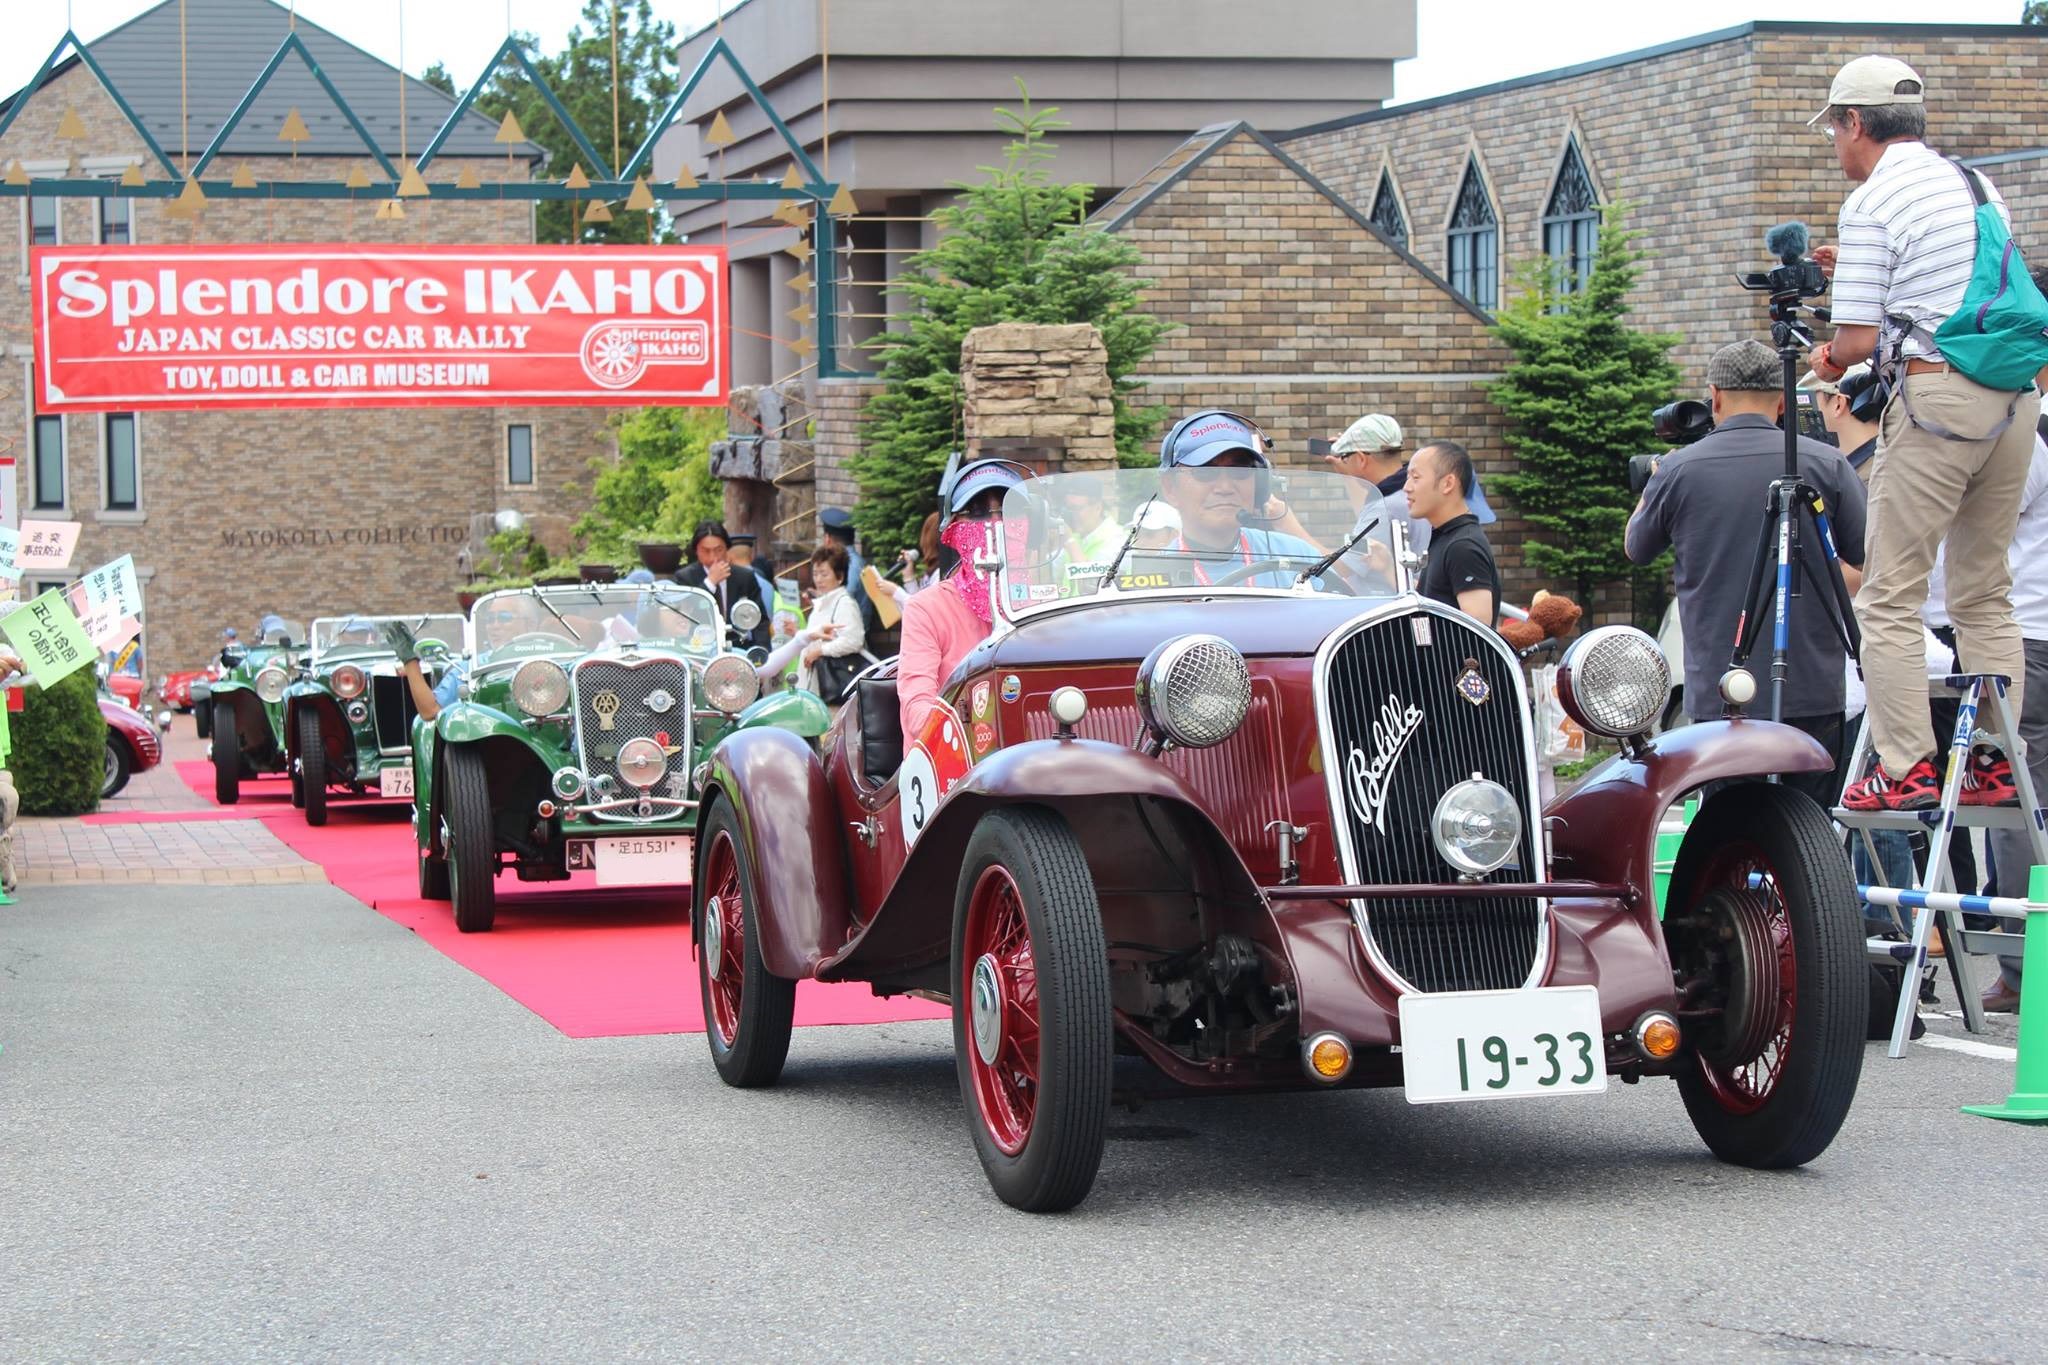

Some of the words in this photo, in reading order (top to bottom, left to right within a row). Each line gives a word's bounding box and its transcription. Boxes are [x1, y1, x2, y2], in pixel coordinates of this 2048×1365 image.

[57, 268, 447, 326] Splendore
[464, 269, 706, 316] IKAHO
[117, 327, 223, 352] JAPAN
[230, 326, 356, 351] CLASSIC
[363, 325, 427, 350] CAR
[433, 325, 531, 350] RALLY
[610, 328, 700, 344] Splendore
[641, 343, 700, 356] IKAHO
[291, 368, 310, 388] &
[313, 366, 368, 387] CAR
[373, 364, 490, 388] MUSEUM
[221, 528, 335, 548] M.YOKOTA
[1120, 575, 1169, 588] ZOIL
[1347, 693, 1424, 836] Balilla
[911, 775, 925, 830] 3
[1456, 1031, 1594, 1092] 19-33
